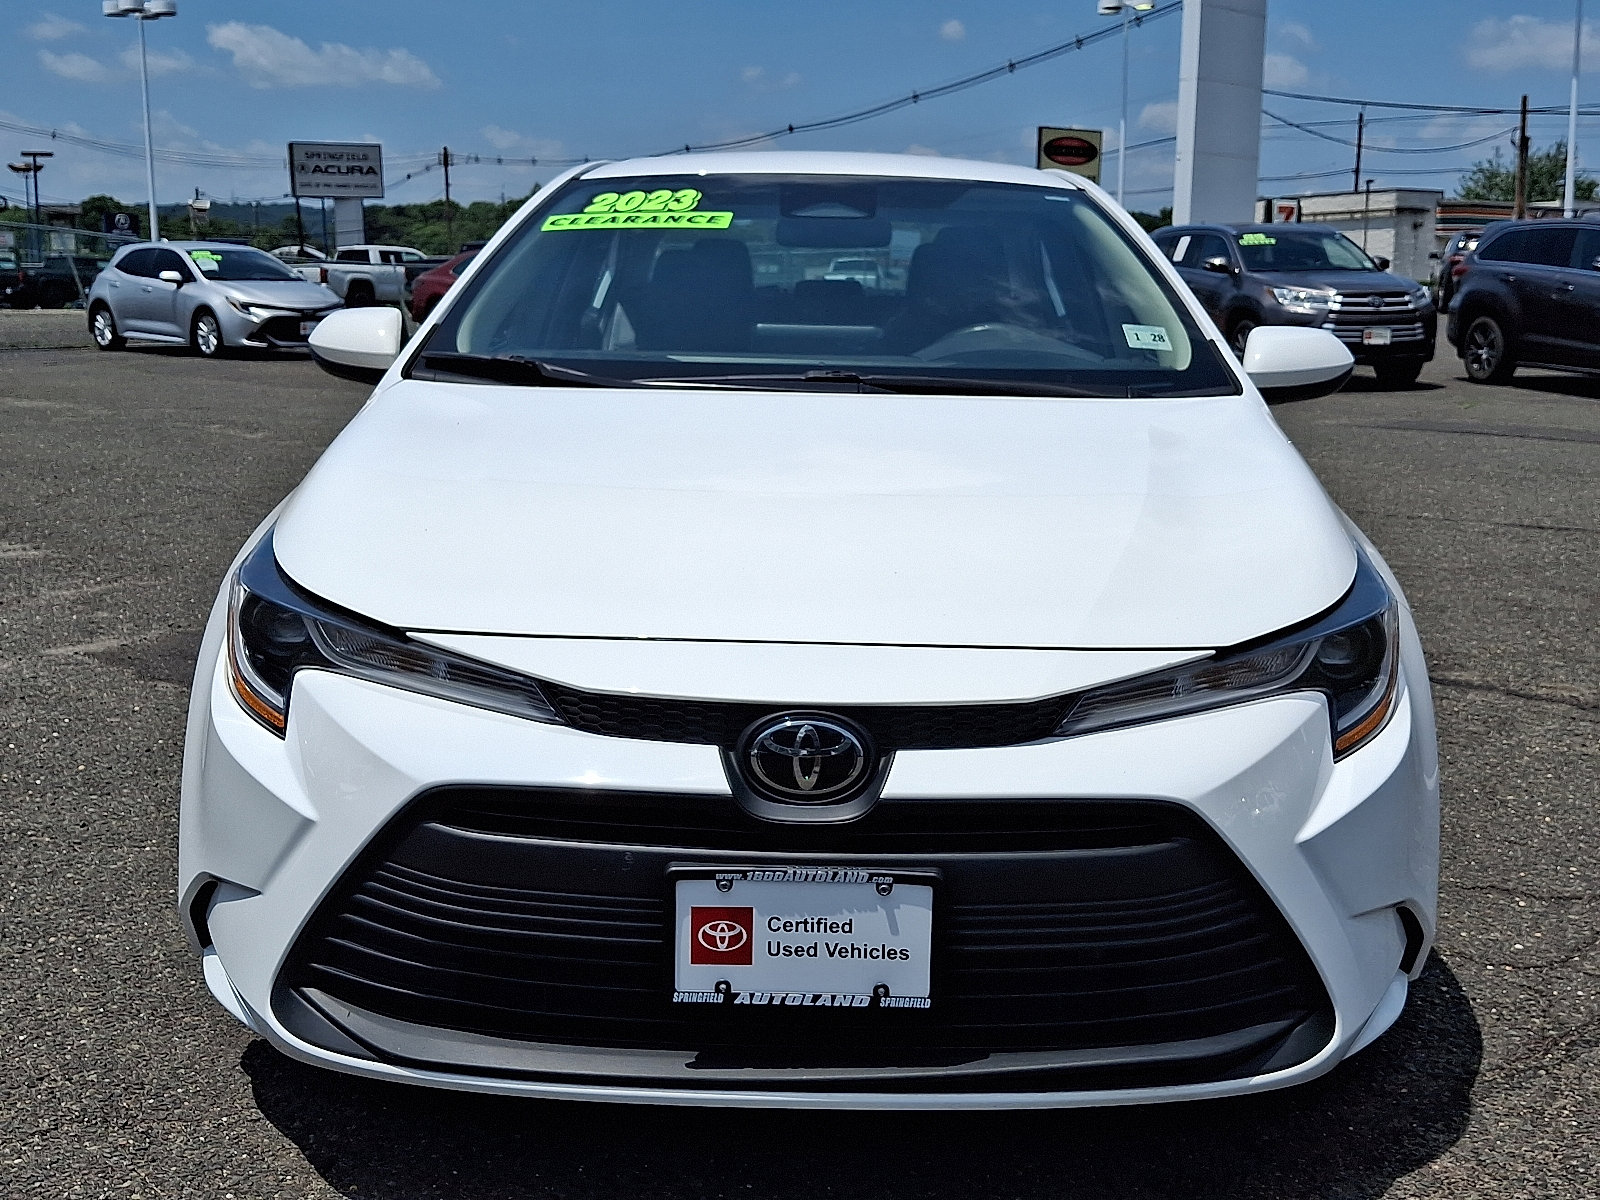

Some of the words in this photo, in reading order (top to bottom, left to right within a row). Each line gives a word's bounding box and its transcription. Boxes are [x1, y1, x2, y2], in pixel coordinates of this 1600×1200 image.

[311, 164, 378, 175] ACURA
[583, 189, 702, 213] 2023
[550, 214, 725, 227] CLEARANCE
[1134, 332, 1141, 341] 1
[1150, 333, 1166, 343] 28
[767, 916, 853, 934] Certified
[767, 940, 818, 958] Used
[825, 941, 910, 961] Vehicles
[672, 992, 724, 1004] SPRINGFIELD
[734, 992, 871, 1007] AUTOLAND
[879, 996, 931, 1009] SPRINGFIELD
